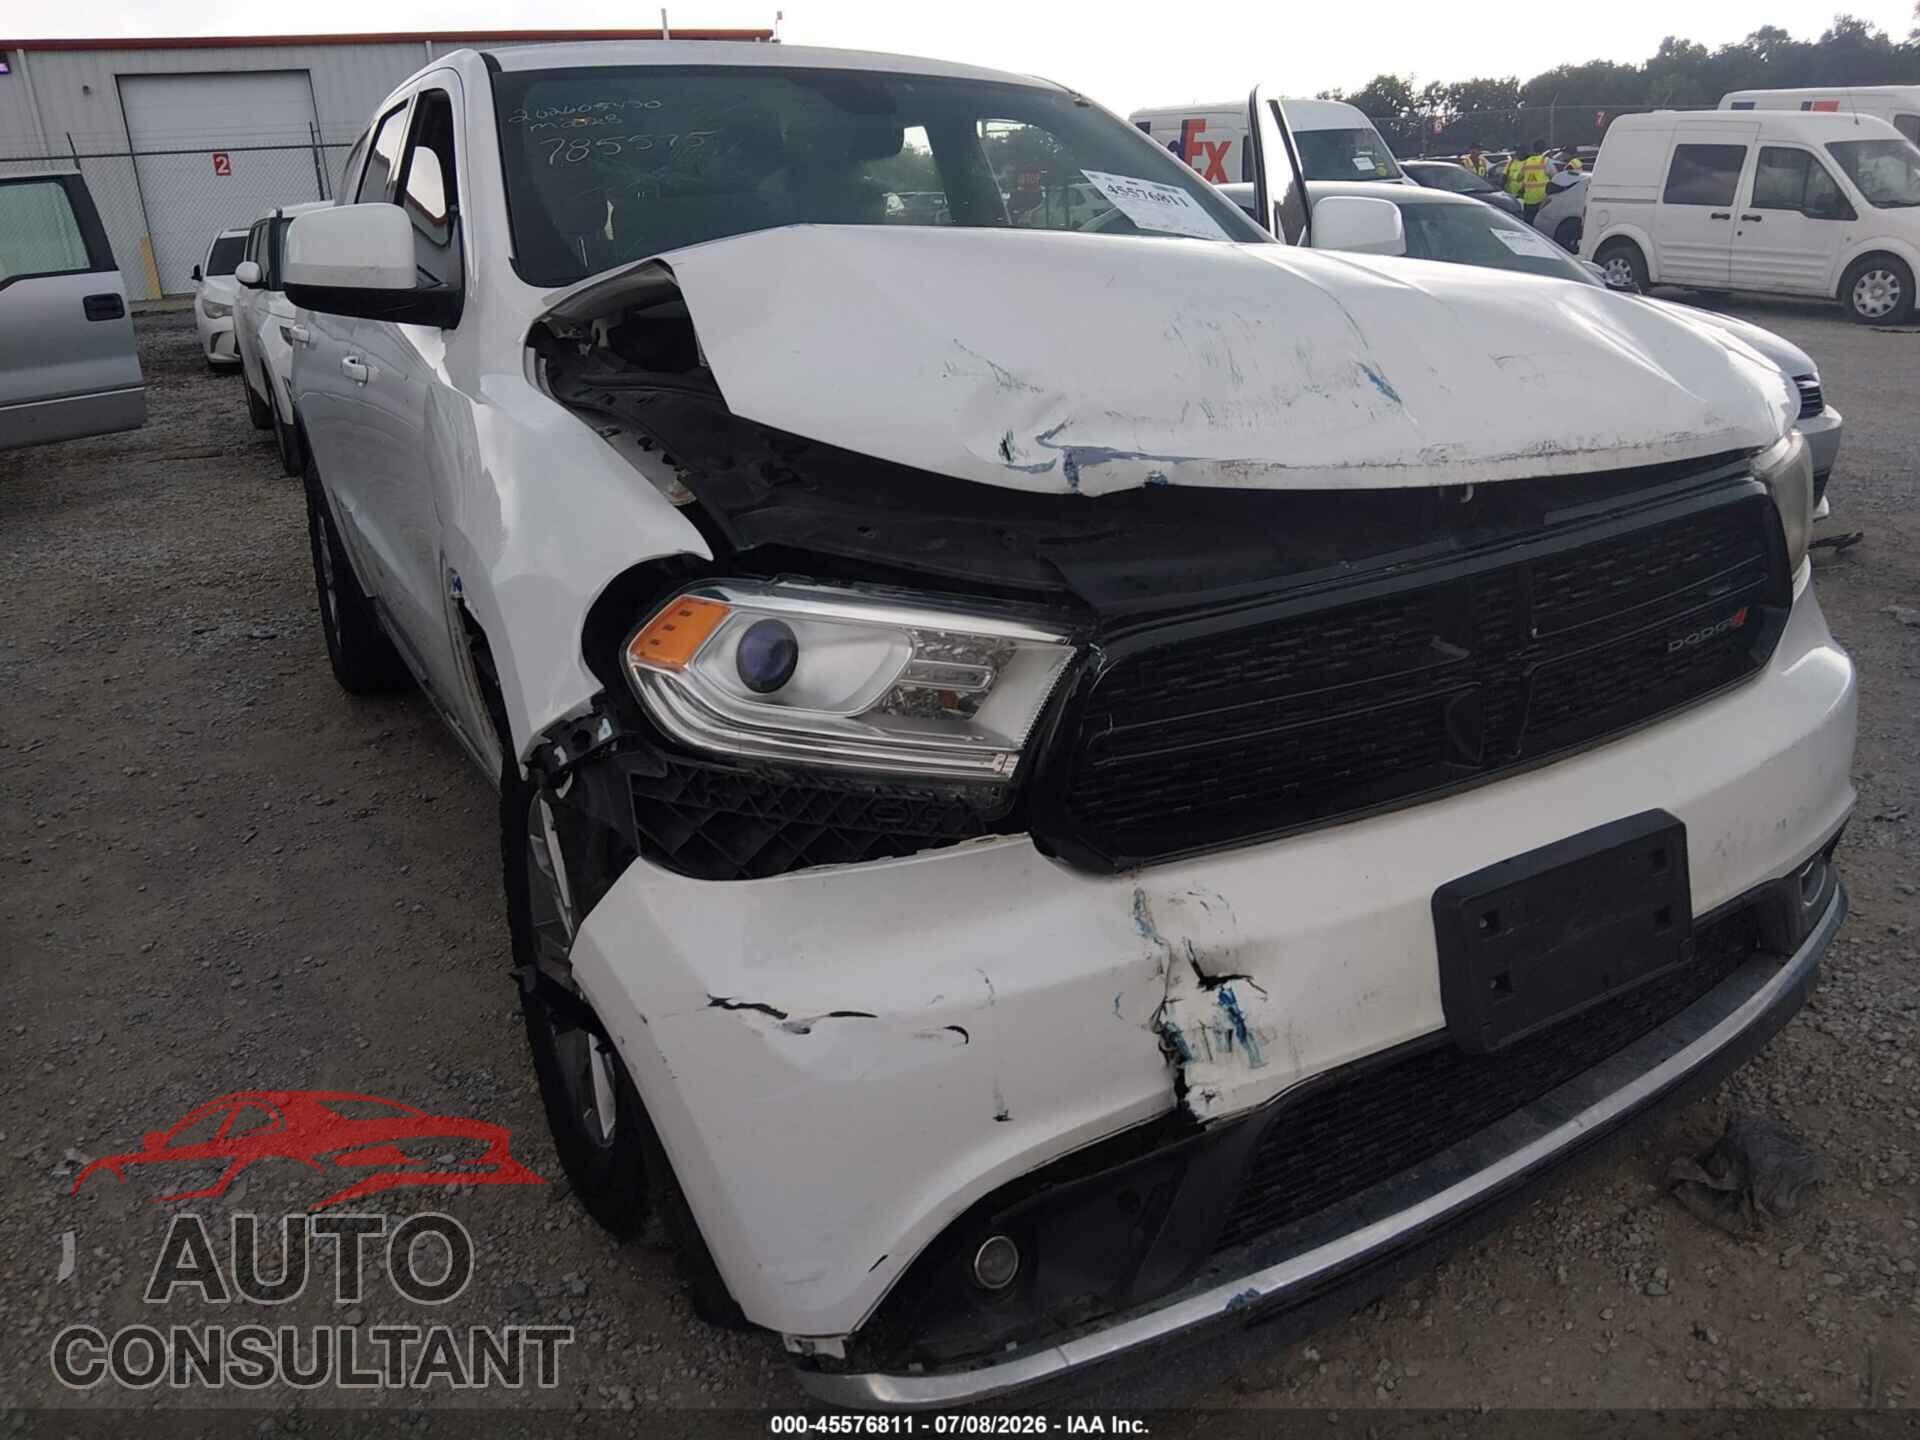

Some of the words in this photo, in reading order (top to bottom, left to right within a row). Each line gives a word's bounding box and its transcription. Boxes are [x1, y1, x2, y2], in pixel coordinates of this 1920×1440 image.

[1137, 118, 1232, 184] dEx
[215, 156, 228, 173] 2
[1107, 183, 1189, 207] 45576811
